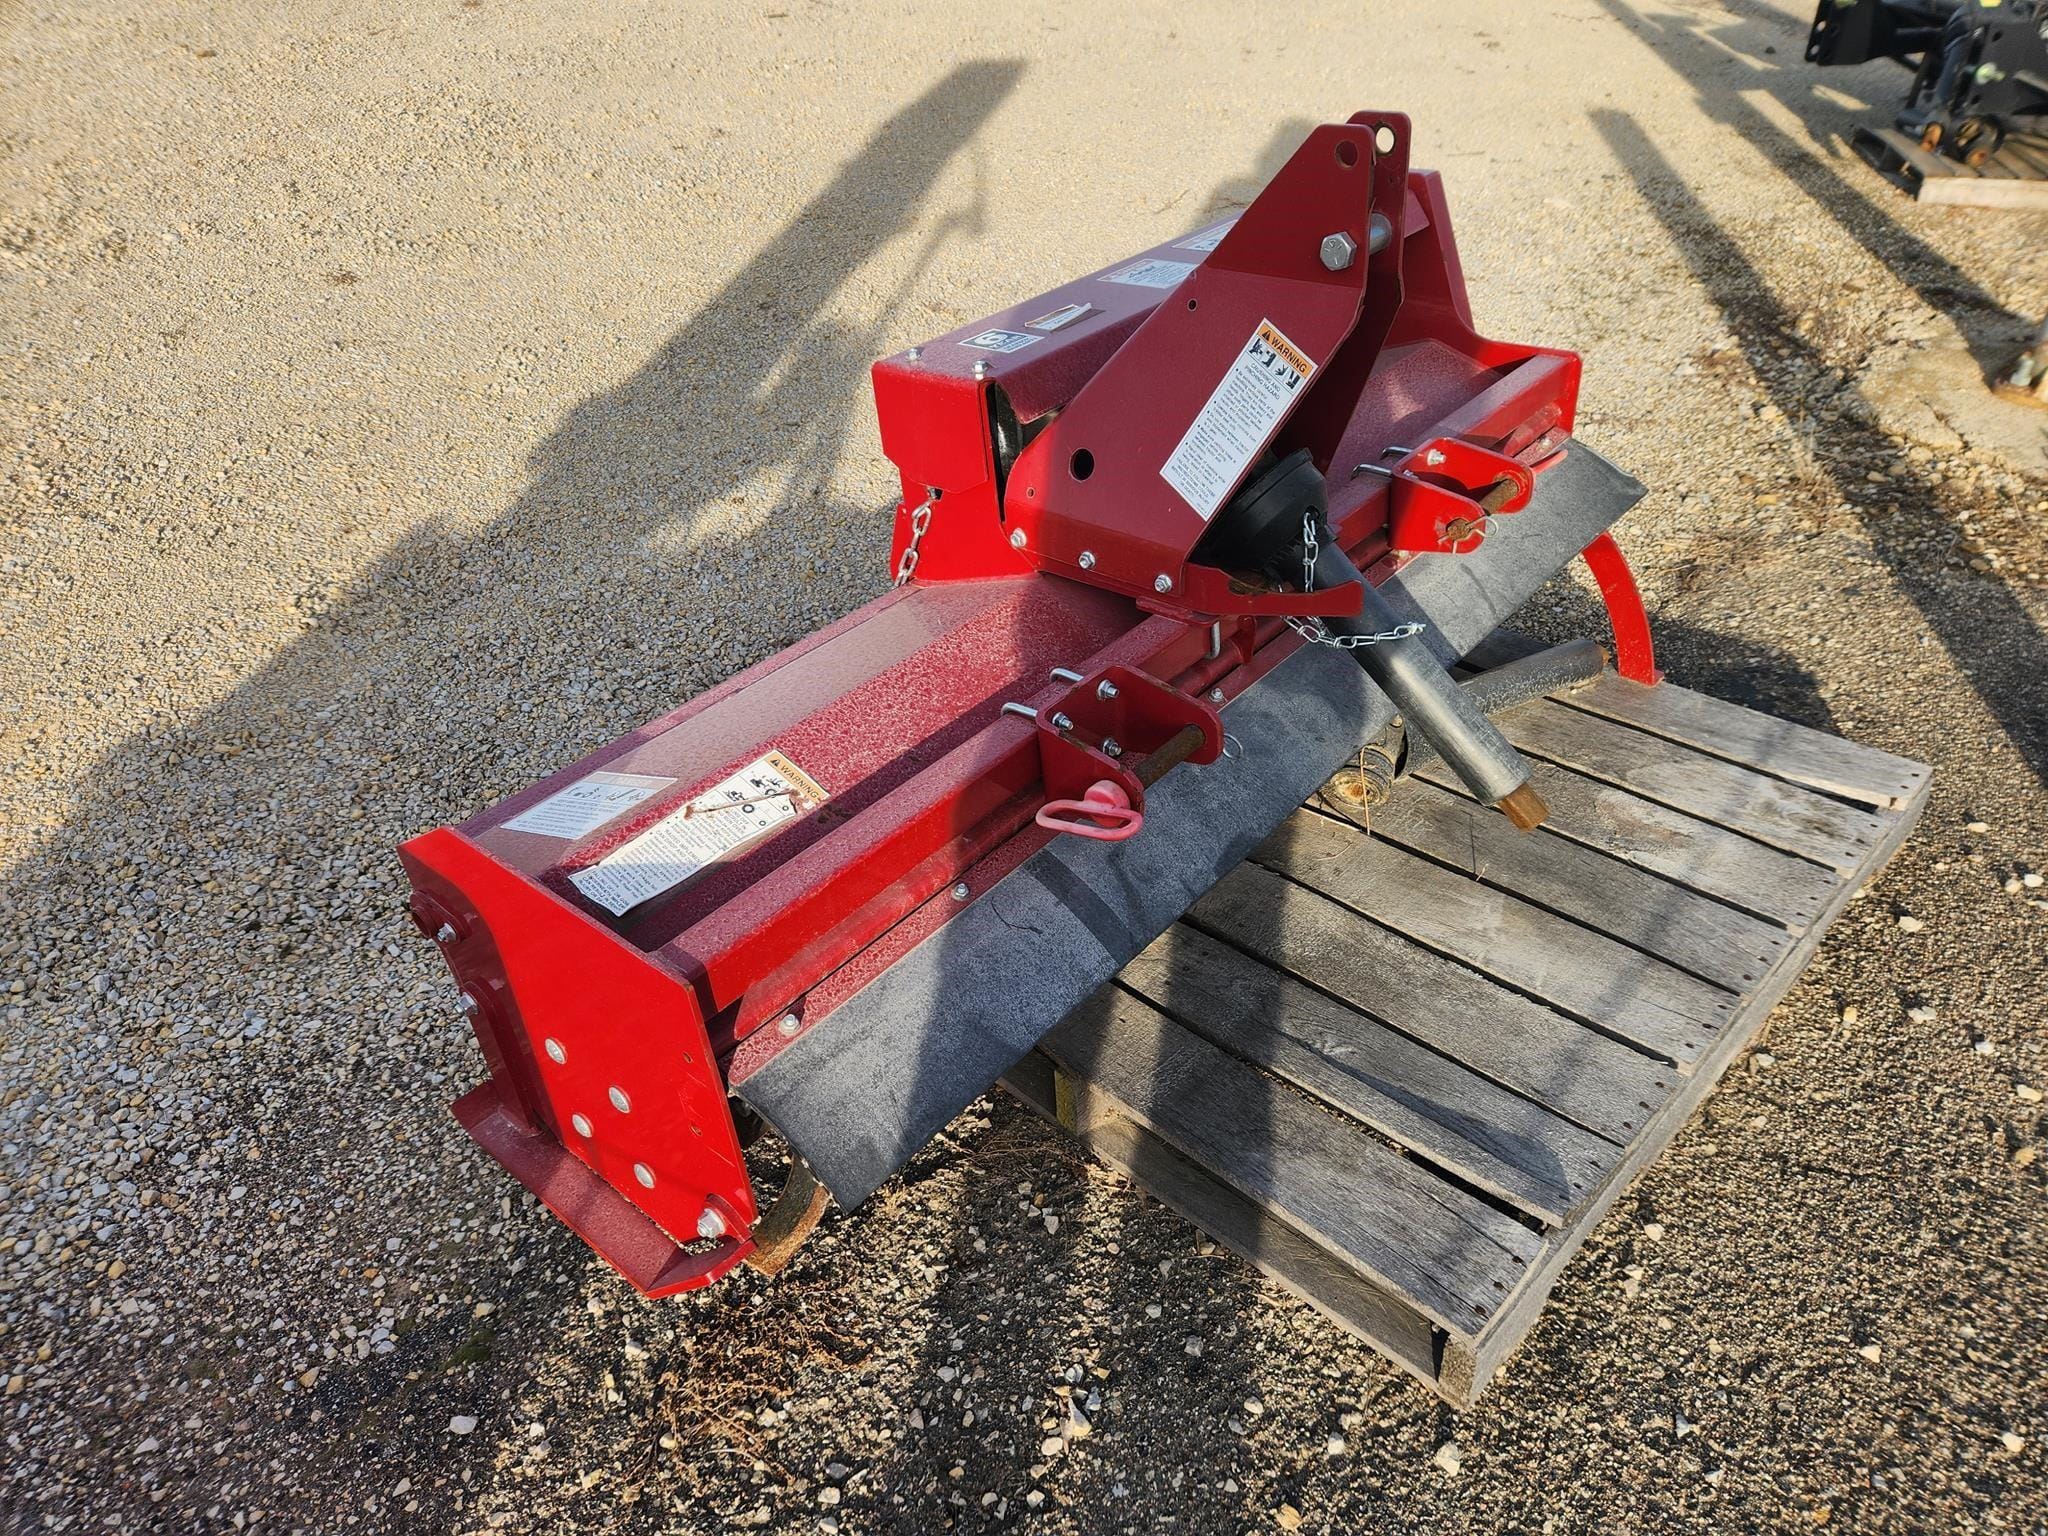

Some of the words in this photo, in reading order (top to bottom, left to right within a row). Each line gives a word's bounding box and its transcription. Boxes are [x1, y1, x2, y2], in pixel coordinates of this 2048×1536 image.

[1271, 337, 1307, 373] WARNING
[1243, 364, 1265, 386] PINCHING
[1261, 381, 1281, 401] HAZARD
[1249, 361, 1272, 384] CRUSHING
[1270, 380, 1281, 393] AND
[780, 764, 819, 798] WARNING
